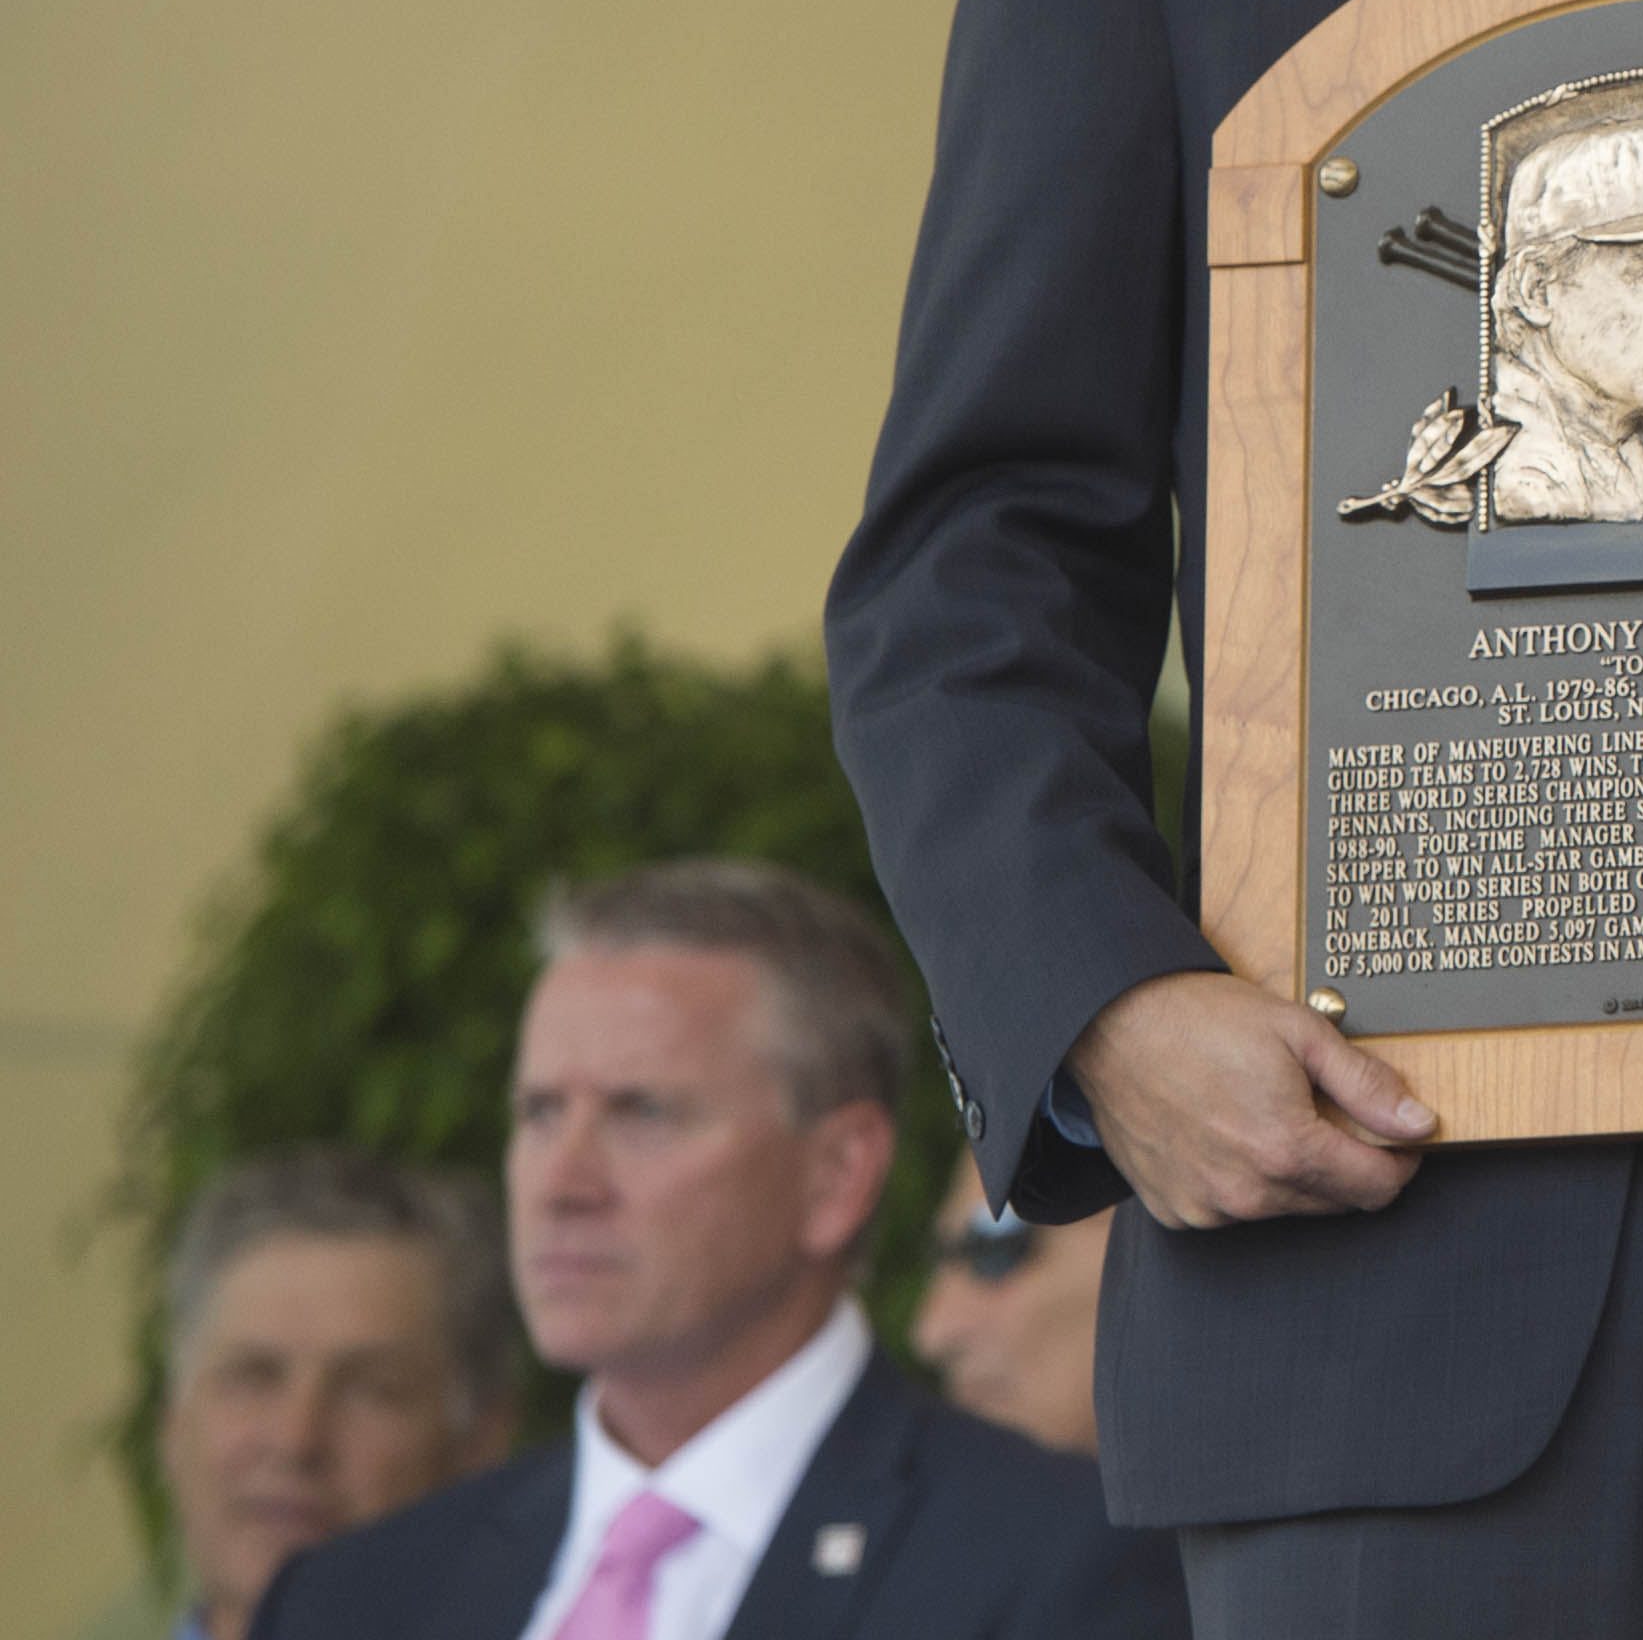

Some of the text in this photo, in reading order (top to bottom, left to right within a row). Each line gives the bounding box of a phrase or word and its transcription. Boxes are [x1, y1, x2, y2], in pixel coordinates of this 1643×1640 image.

[1467, 621, 1643, 659] ANTHONY
[1365, 685, 1485, 712] CHICAGO,
[1490, 682, 1537, 706] A.L.
[1545, 677, 1637, 703] 1979-86;
[1497, 704, 1532, 726] ST.
[1539, 699, 1620, 724] LOUIS,
[1328, 744, 1404, 769] MASTER
[1413, 742, 1440, 765] OF
[1448, 734, 1592, 763] MANEUVERING
[1327, 767, 1404, 792] GUIDED
[1409, 764, 1474, 788] TEAMS
[1479, 762, 1506, 784] TO
[1513, 759, 1562, 782] 2,728
[1568, 756, 1624, 781] WINS,
[1327, 791, 1391, 815] THREE
[1397, 787, 1467, 811] WORLD
[1473, 783, 1539, 807] SERIES
[1327, 812, 1435, 838] PENNANTS,
[1445, 805, 1554, 832] INCLUDING
[1562, 801, 1627, 825] THREE
[1329, 836, 1402, 860] 1988-90.
[1417, 830, 1525, 855] FOUR-TIME
[1539, 825, 1635, 849] MANAGER
[1326, 860, 1407, 884] SKIPPER
[1413, 858, 1440, 880] TO
[1445, 856, 1484, 878] WIN
[1490, 851, 1582, 875] ALL-STAR
[1327, 886, 1352, 908] TO
[1358, 884, 1395, 906] WIN
[1401, 880, 1471, 904] WORLD
[1476, 876, 1543, 900] SERIES
[1549, 874, 1570, 896] IN
[1578, 871, 1629, 894] BOTH
[1326, 910, 1347, 931] IN
[1369, 907, 1410, 929] 2011
[1432, 902, 1500, 925] SERIES
[1521, 894, 1636, 921] PROPELLED
[1325, 928, 1435, 953] COMEBACK.
[1444, 923, 1540, 947] MANAGED
[1548, 920, 1596, 941] 5,097
[1325, 956, 1351, 976] OF
[1356, 953, 1403, 975] 5,000
[1407, 952, 1434, 972] OR
[1439, 949, 1493, 970] MORE
[1497, 943, 1594, 968] CONTESTS
[1599, 942, 1620, 962] IN
